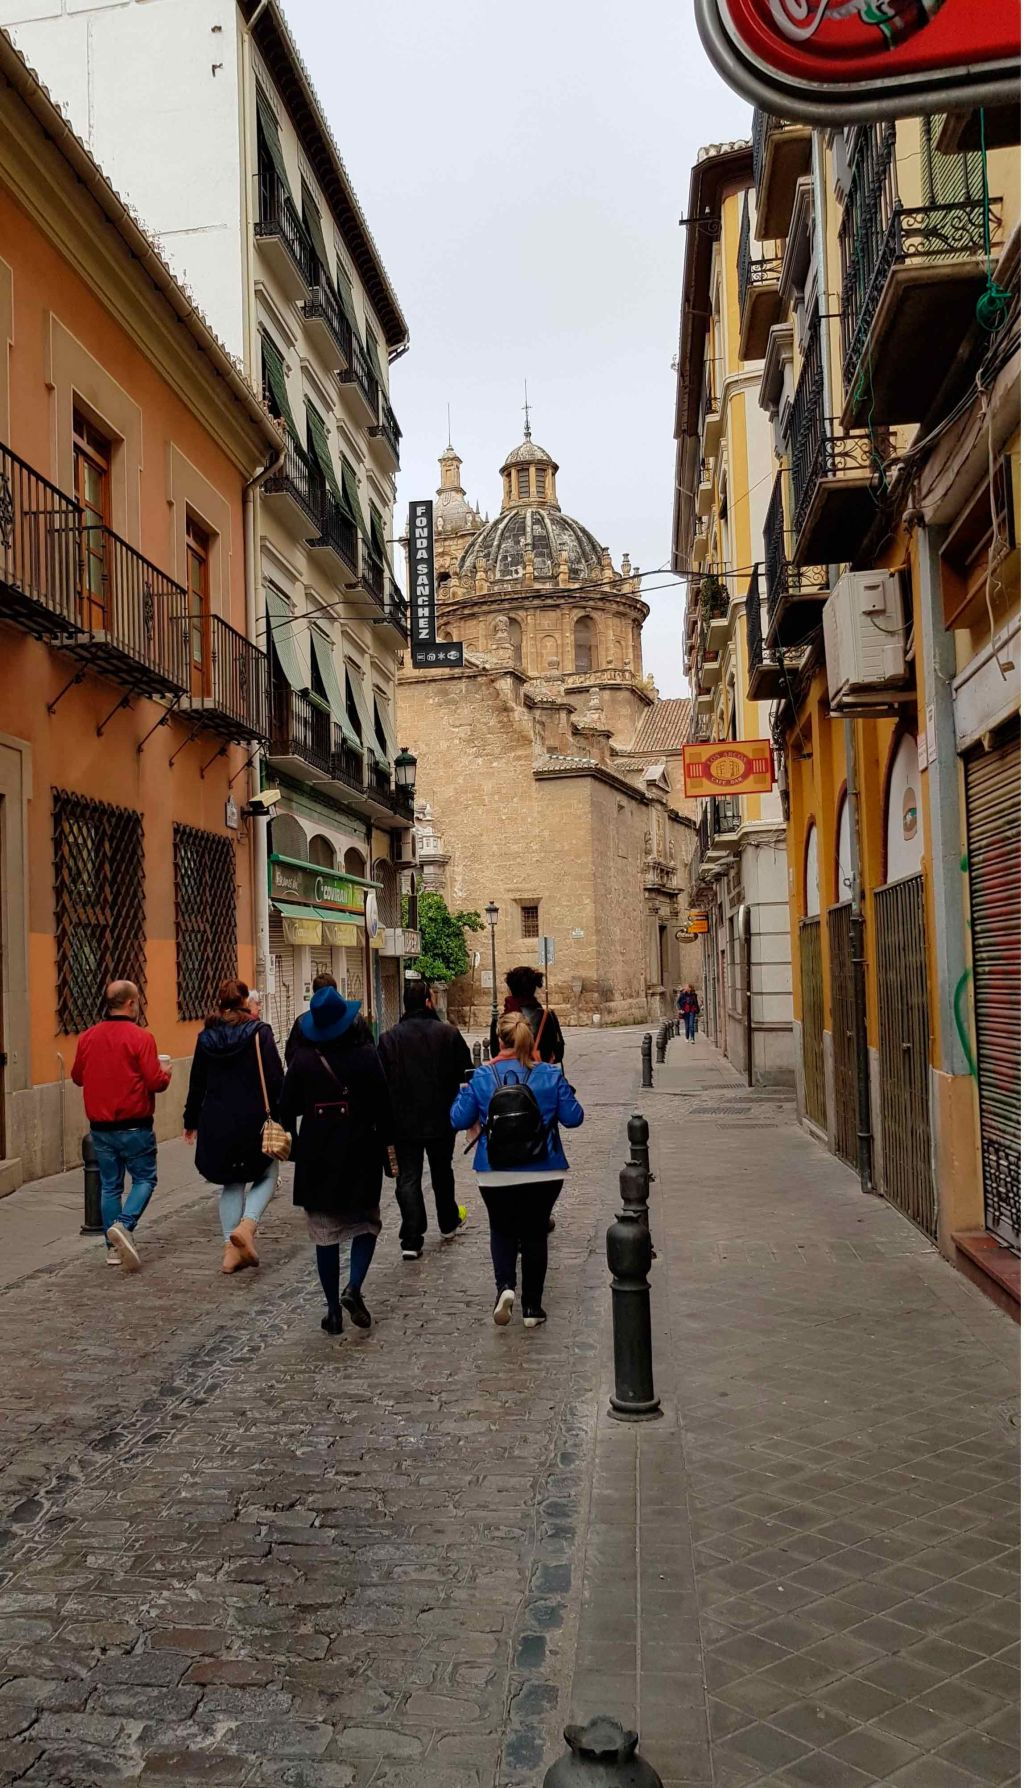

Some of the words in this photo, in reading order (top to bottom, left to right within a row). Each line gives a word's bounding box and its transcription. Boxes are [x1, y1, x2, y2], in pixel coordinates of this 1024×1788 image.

[415, 506, 428, 560] FONDA
[416, 563, 430, 639] SANCHEZ
[706, 753, 721, 765] LOS
[722, 751, 747, 763] ARCOS
[730, 776, 743, 785] BAR
